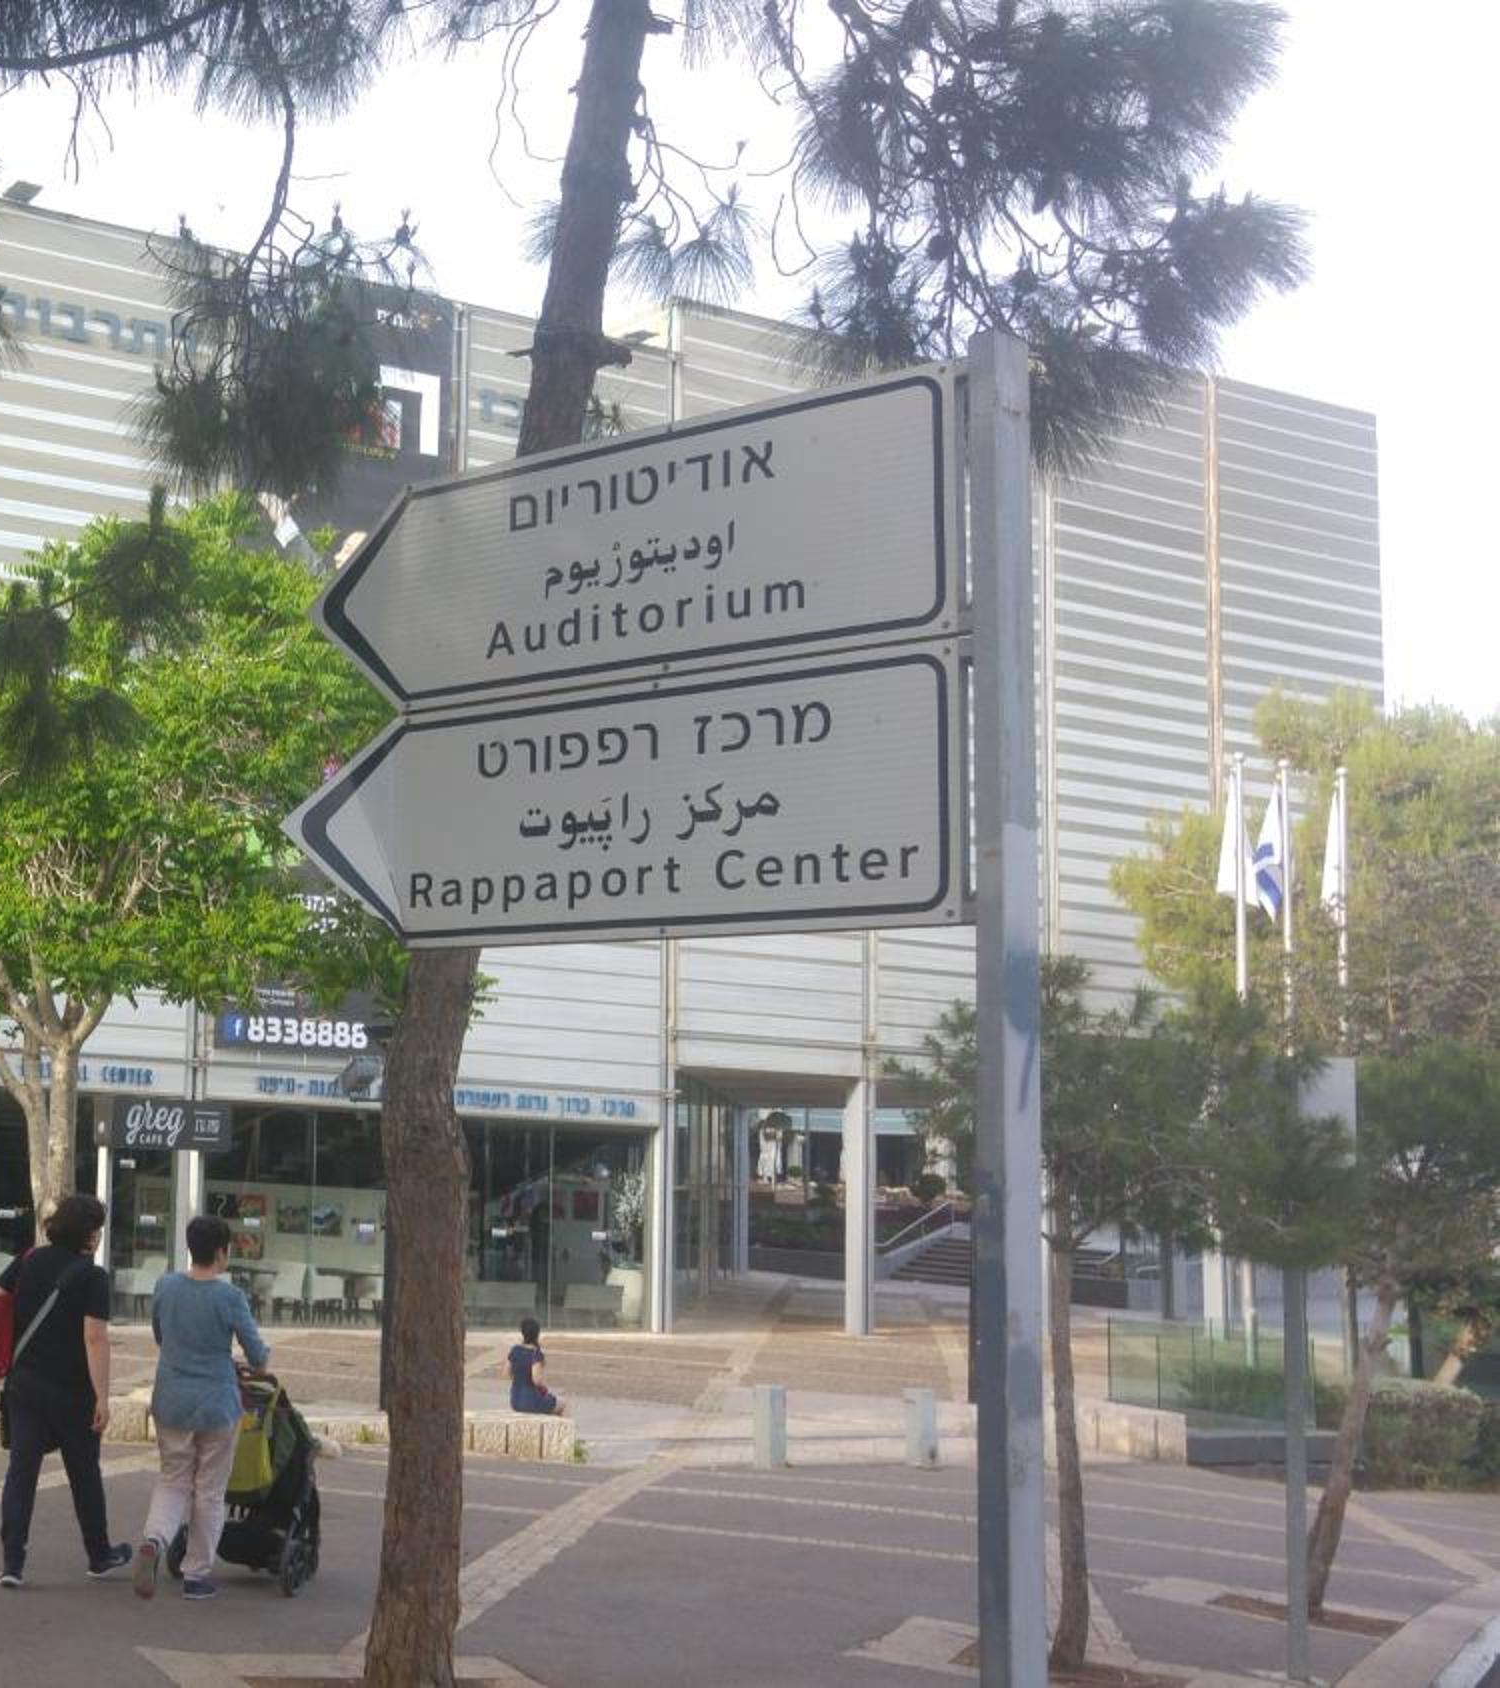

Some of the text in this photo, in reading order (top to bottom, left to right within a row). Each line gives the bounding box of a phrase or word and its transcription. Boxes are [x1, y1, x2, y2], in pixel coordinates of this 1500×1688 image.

[509, 440, 775, 532] אודיטוריום
[485, 577, 806, 660] Auditorium
[477, 700, 833, 778] מרכז רפפורט
[675, 781, 782, 841] مركز
[408, 843, 920, 915] Rappaport Center
[125, 1100, 185, 1147] greg
